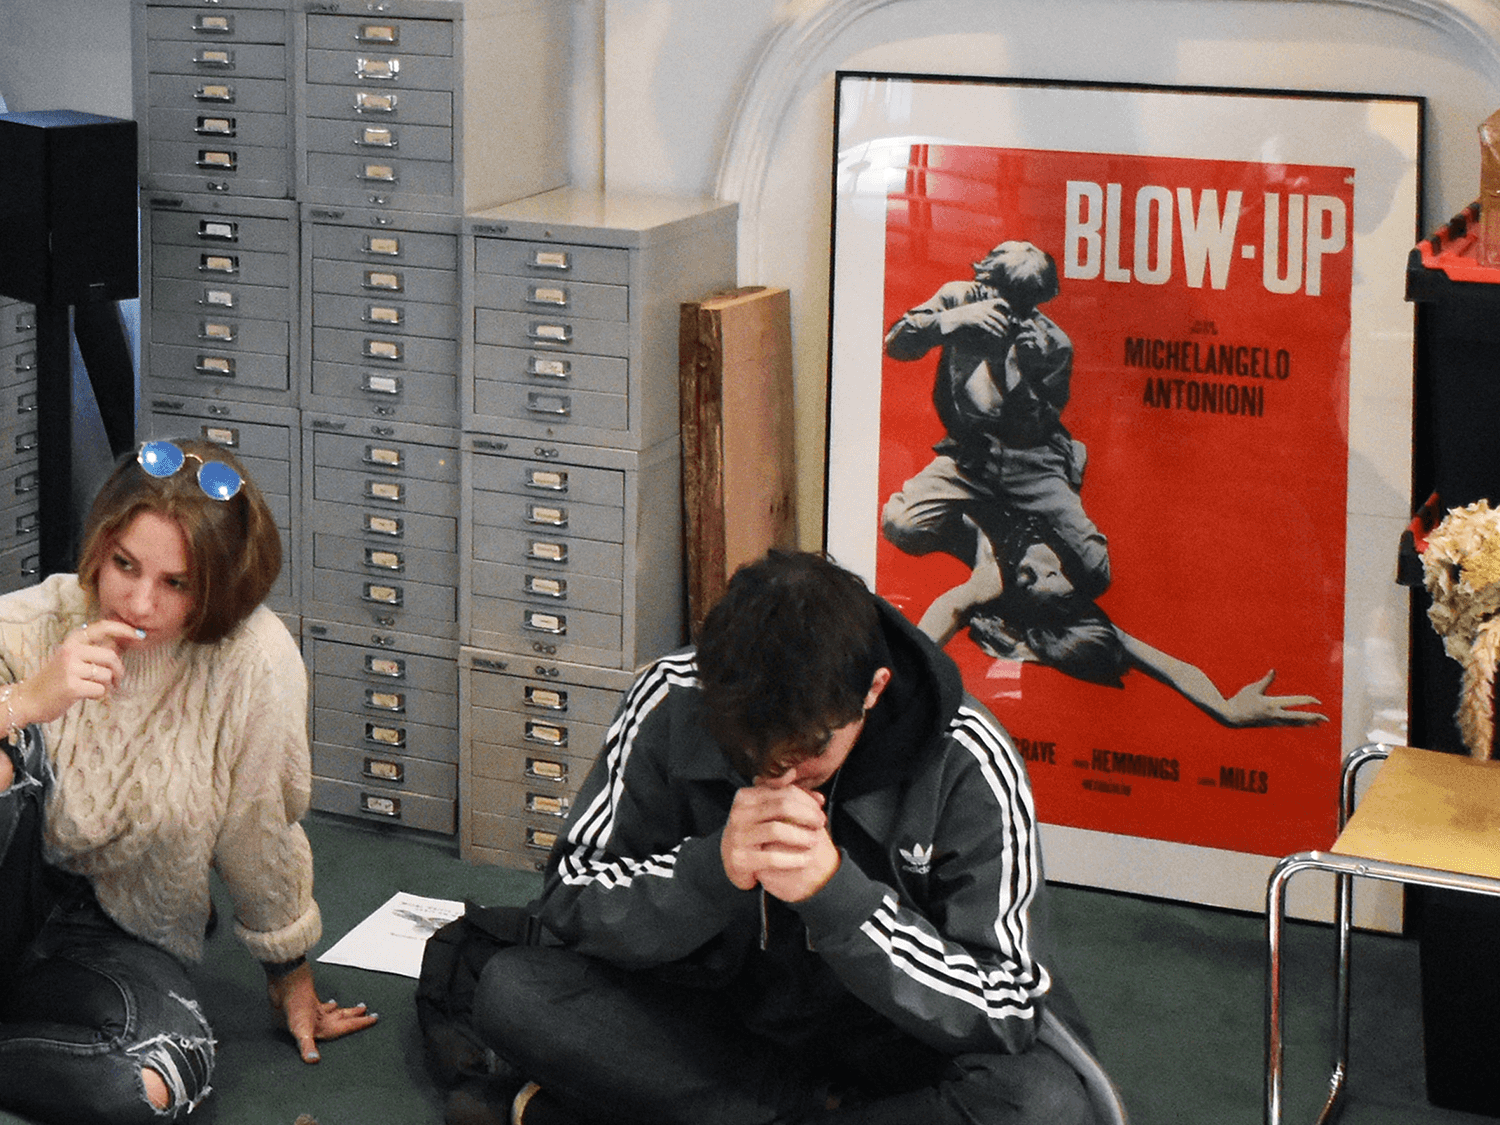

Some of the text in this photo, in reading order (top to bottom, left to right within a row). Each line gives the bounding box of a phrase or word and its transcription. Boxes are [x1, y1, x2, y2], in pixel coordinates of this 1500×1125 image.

[1064, 180, 1347, 296] BLOW-UP
[1124, 336, 1291, 380] MICHELANGELO
[1142, 377, 1265, 417] ANTONIONI
[1091, 748, 1181, 782] HEMMINGS
[1219, 765, 1269, 795] MILES
